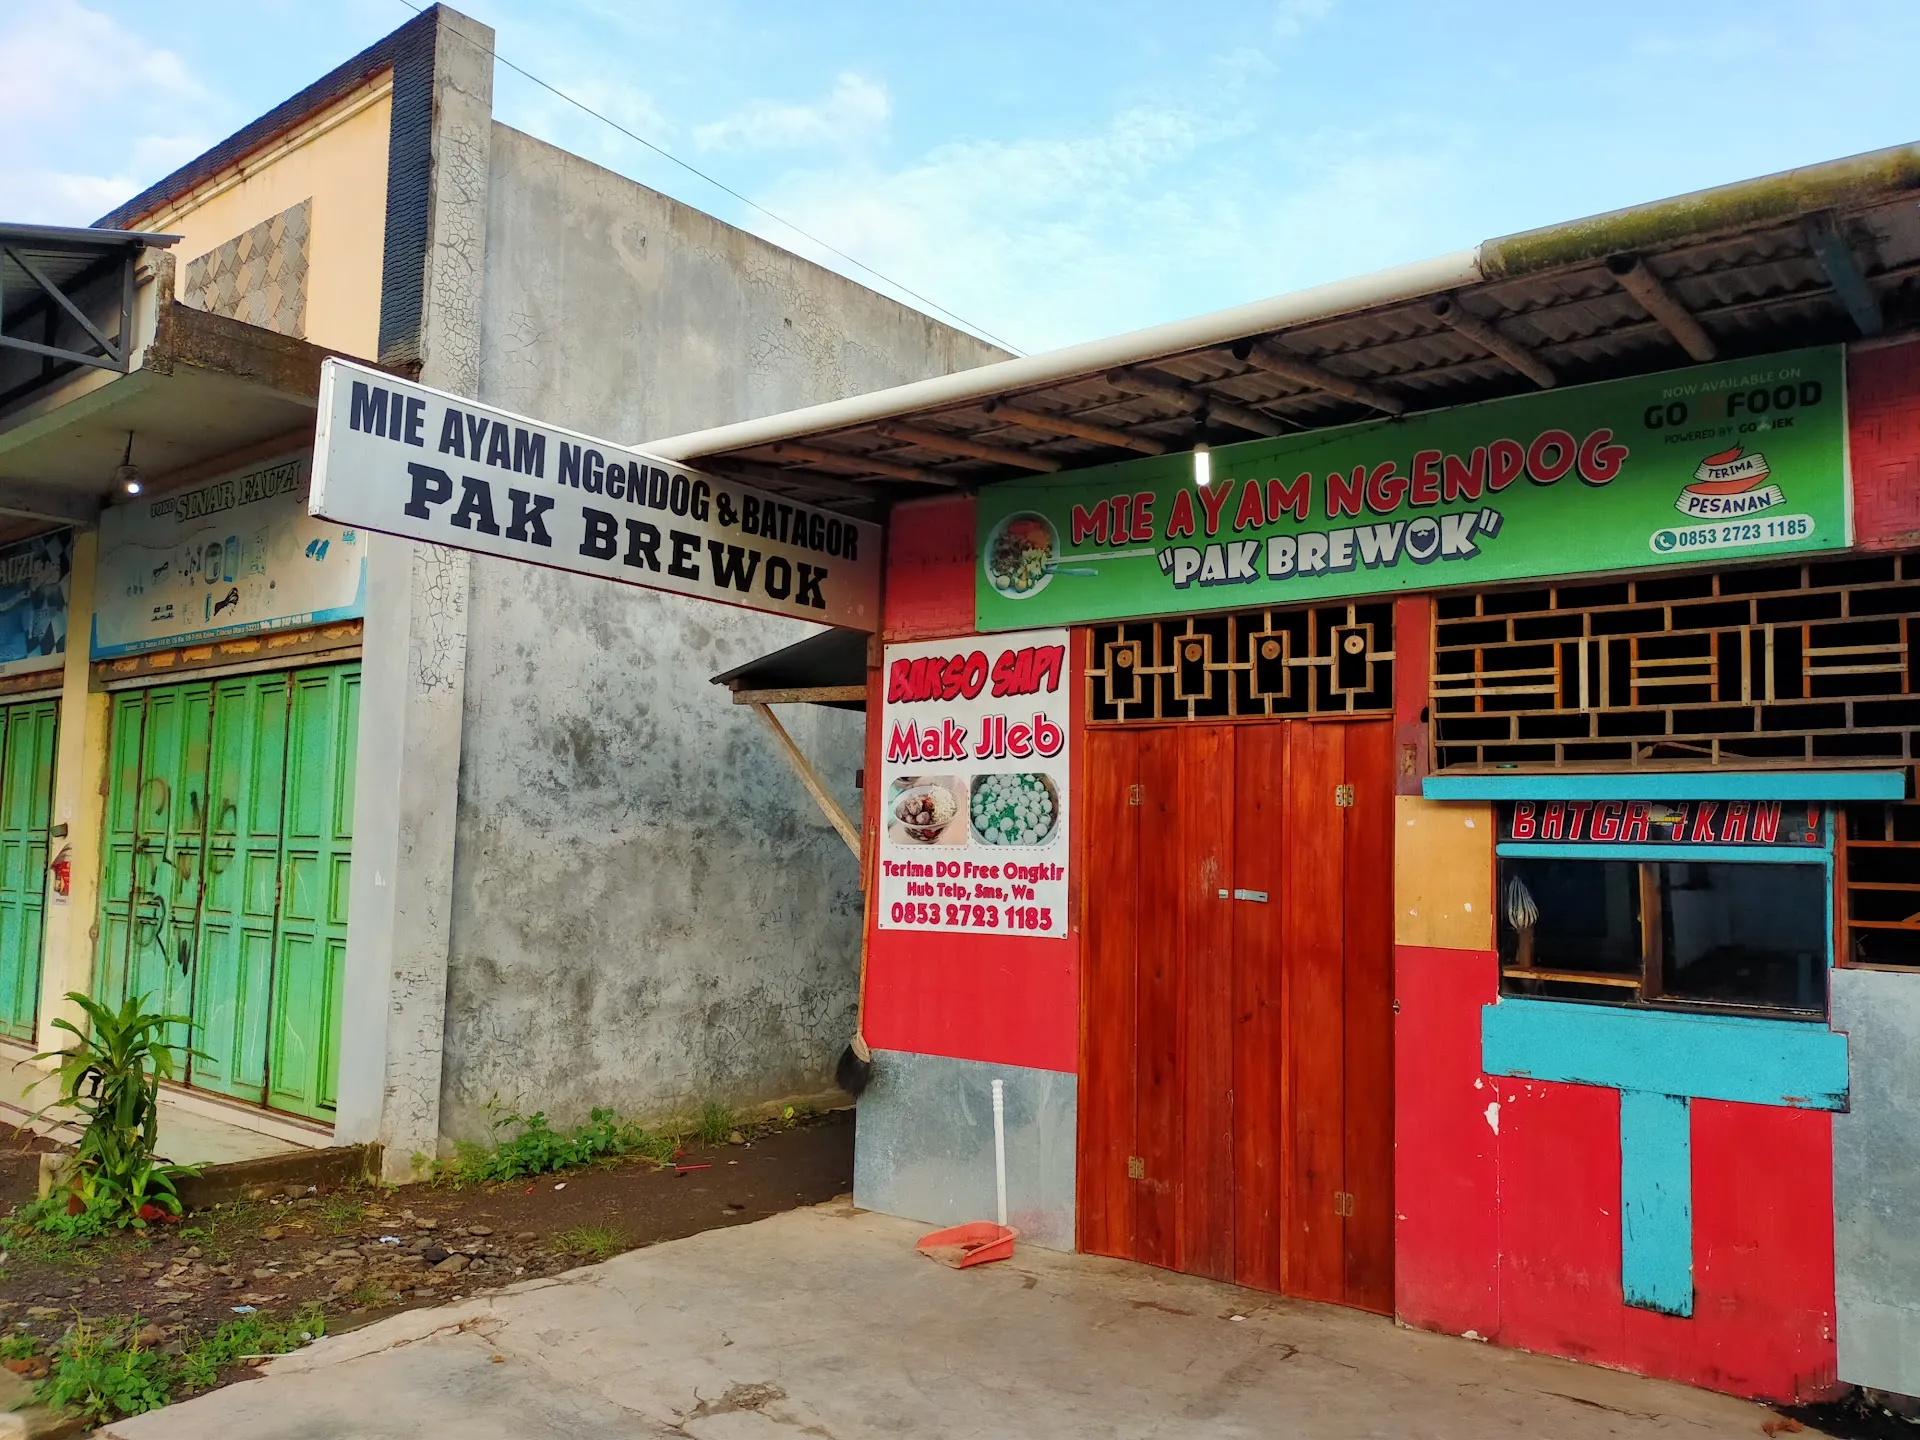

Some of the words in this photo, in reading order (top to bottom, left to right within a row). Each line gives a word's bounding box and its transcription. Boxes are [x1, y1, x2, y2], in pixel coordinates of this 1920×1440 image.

[1663, 384, 1697, 399] NOW
[1701, 370, 1775, 392] AVAILABLE
[1779, 367, 1801, 379] ON
[1644, 402, 1688, 430] GO
[1727, 380, 1822, 418] FOOD
[1665, 428, 1715, 444] POWERED
[1719, 426, 1733, 438] BY
[350, 380, 426, 447] MIE
[438, 408, 546, 479] AYAM
[558, 441, 711, 522] NGeNDOG
[715, 492, 740, 527] &
[741, 494, 859, 562] BATAGOR
[1071, 492, 1156, 547] MIE
[1165, 473, 1312, 541] AYAM
[1325, 428, 1630, 517] NGENDOG
[1708, 461, 1753, 479] TERIMA
[151, 498, 175, 518] TOKO
[176, 481, 235, 523] SINAR
[238, 460, 302, 506] FAUZI
[1688, 492, 1772, 513] PESANAN
[404, 461, 555, 548] PAK
[579, 507, 829, 610] BREWOK
[1679, 528, 1717, 547] 0853
[1722, 524, 1761, 543] 2723
[1768, 519, 1807, 537] 1185
[1157, 539, 1263, 589] "PAK
[887, 650, 989, 704] BAKSO
[991, 644, 1065, 699] SAPI
[886, 717, 968, 764] Mak
[975, 711, 1065, 760] Jleb
[883, 860, 933, 878] Terima
[936, 861, 961, 879] DO
[964, 862, 1000, 880] Free
[1003, 861, 1065, 884] Ongkir
[907, 882, 934, 898] Hub
[936, 882, 971, 901] Telp,
[974, 883, 1008, 902] Sms,
[1012, 884, 1035, 901] Wa
[891, 902, 941, 925] 0853
[945, 903, 999, 928] 2723
[1004, 905, 1053, 931] 1185
